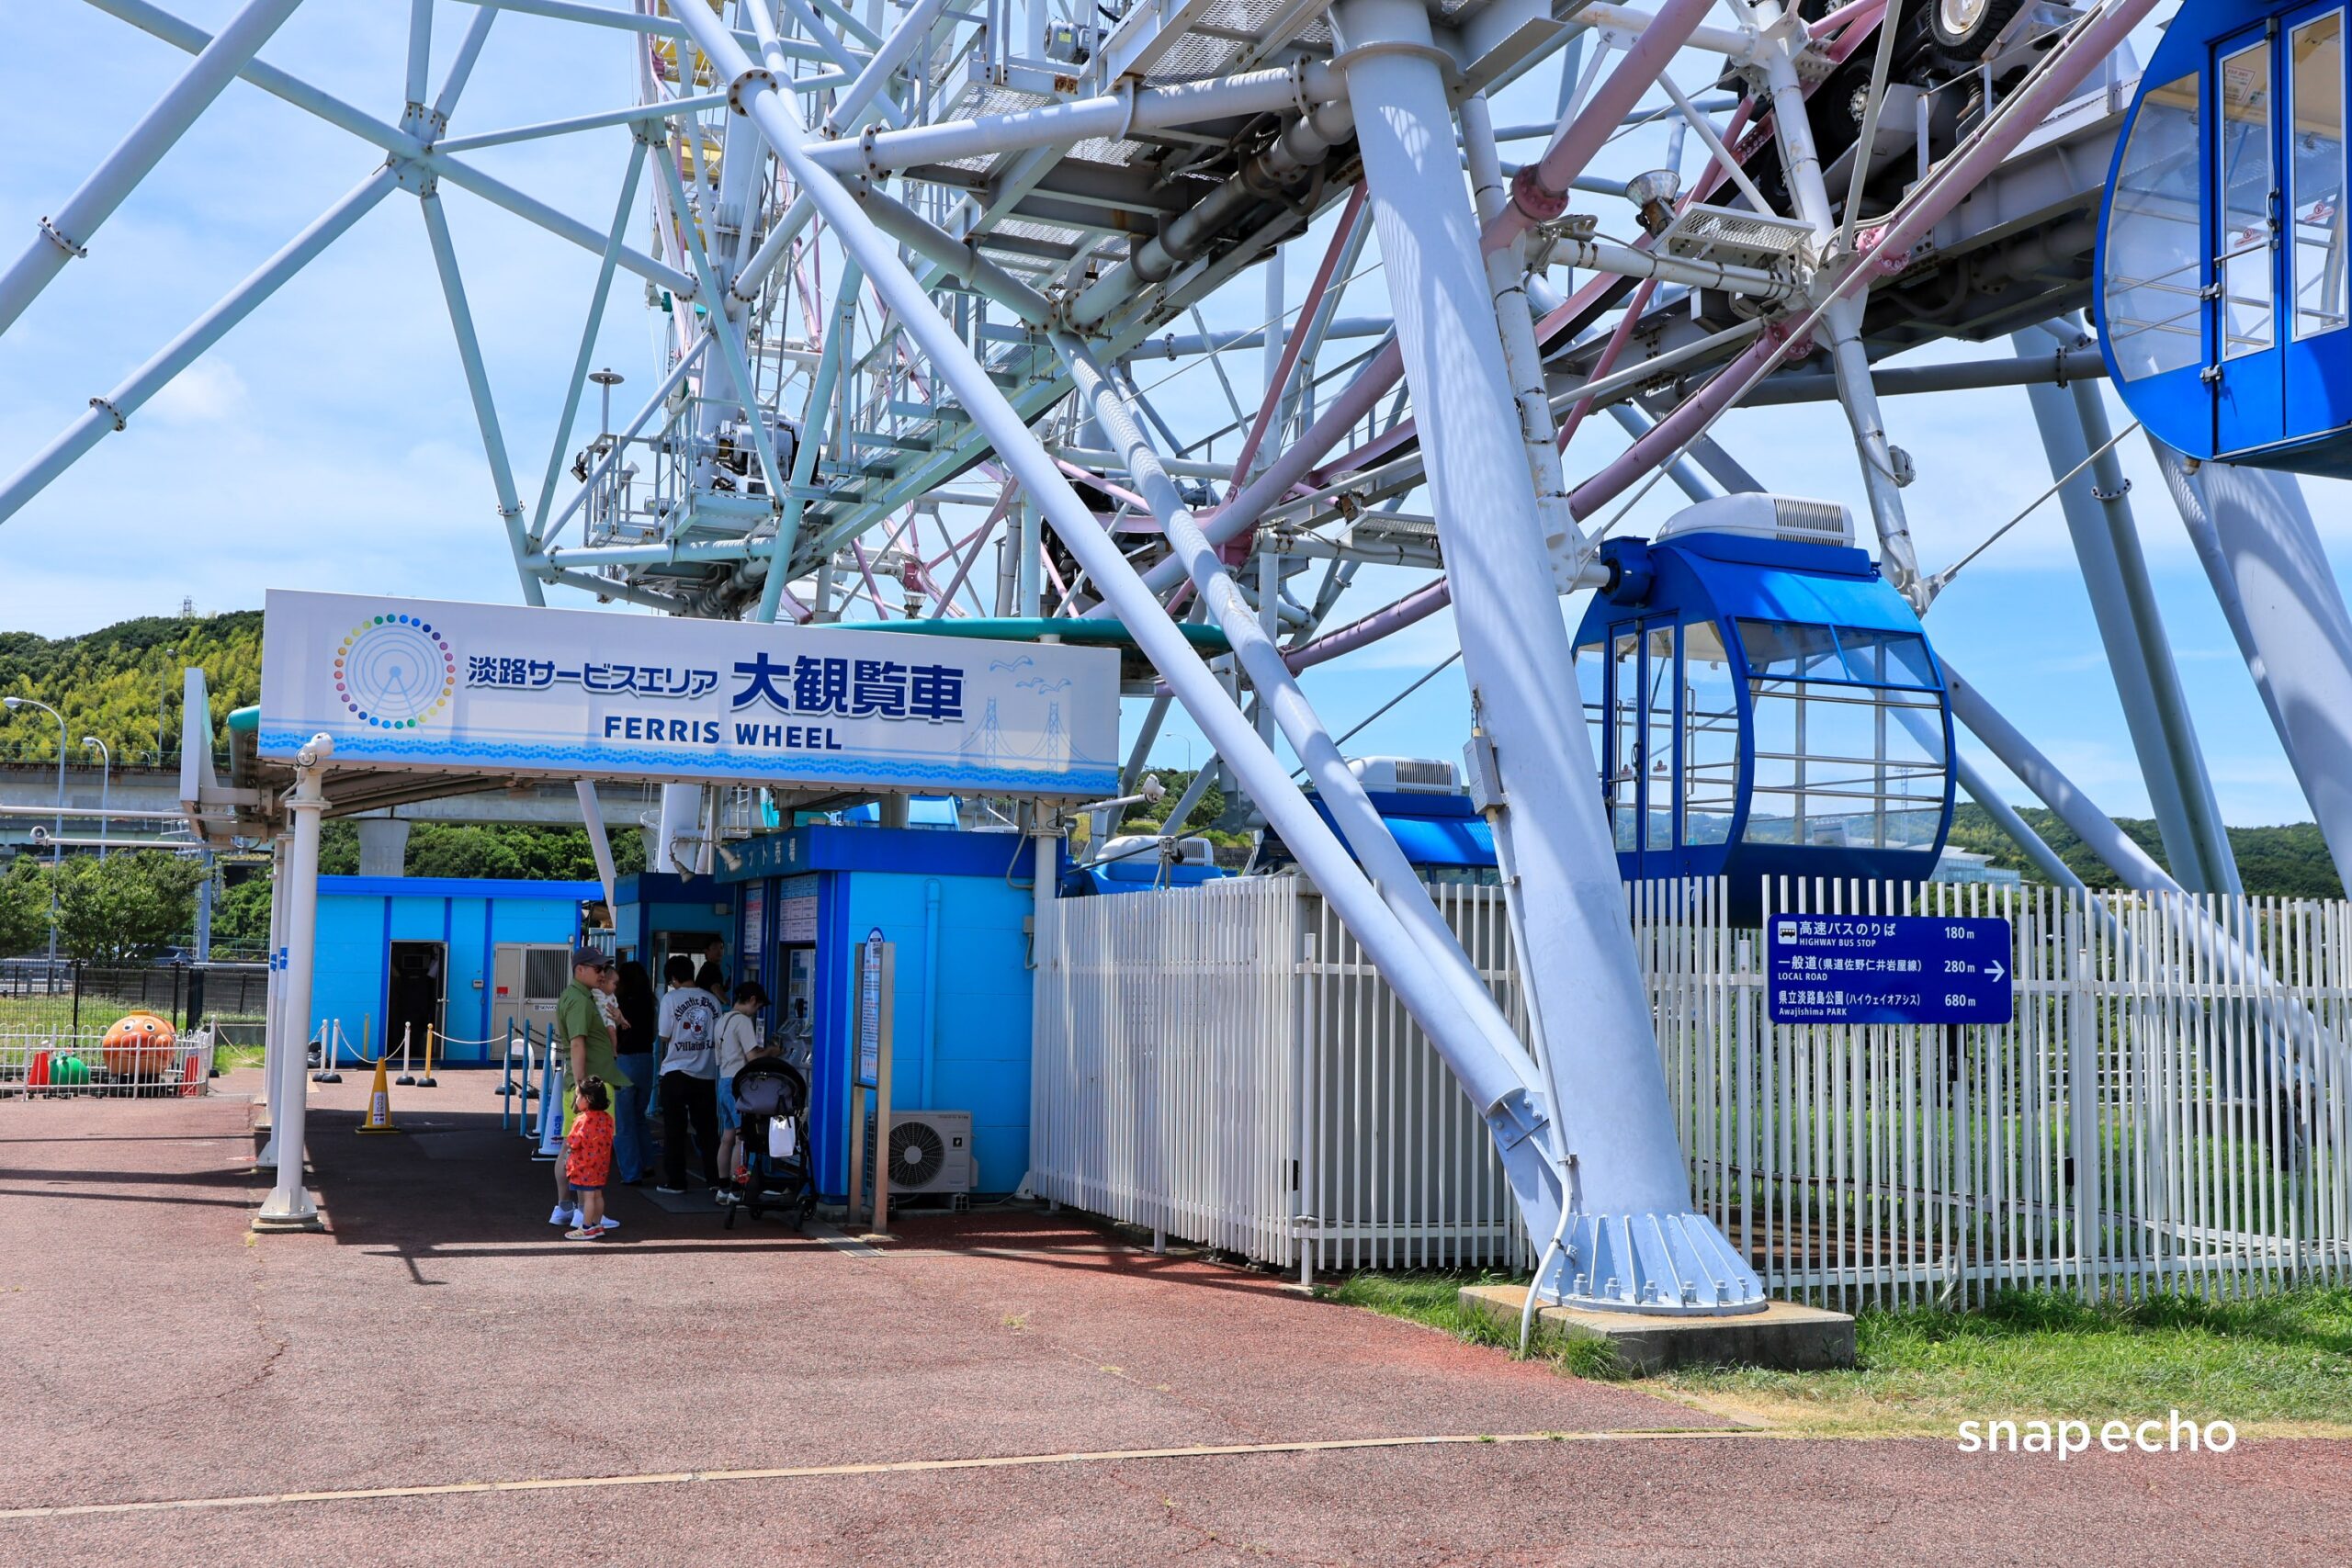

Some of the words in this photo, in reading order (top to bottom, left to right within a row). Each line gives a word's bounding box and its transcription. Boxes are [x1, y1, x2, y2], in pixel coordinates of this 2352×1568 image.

[468, 655, 718, 696] 淡路サービスエリア
[731, 652, 964, 719] 大観覧車
[605, 716, 720, 745] FERRIS
[735, 722, 842, 750] WHEEL
[1799, 920, 1896, 937] 高速バスのりば
[1799, 938, 1837, 946] HIGHWAY
[1838, 939, 1854, 947] BUS
[1857, 939, 1876, 947] STOP
[1778, 972, 1803, 981] LOCAL
[1805, 973, 1827, 981] ROAD
[1779, 1007, 1824, 1017] Awajishima
[1826, 1008, 1847, 1016] PARK
